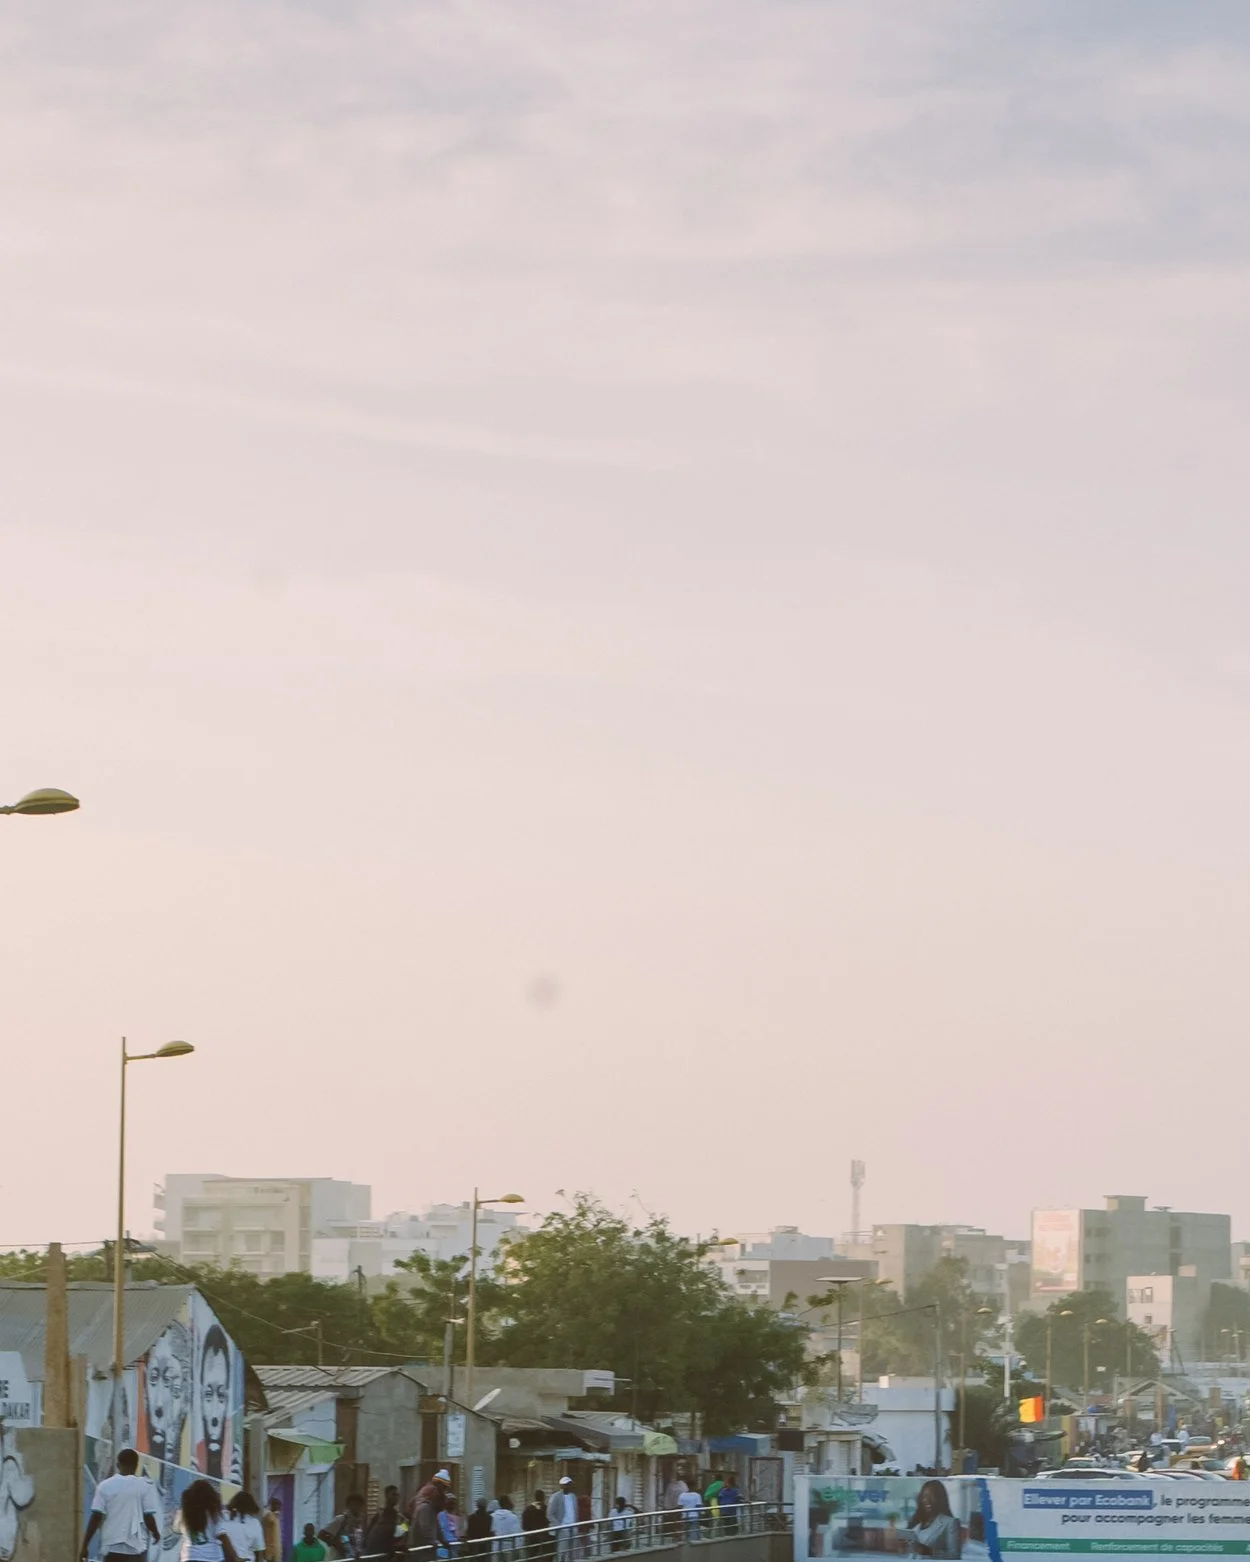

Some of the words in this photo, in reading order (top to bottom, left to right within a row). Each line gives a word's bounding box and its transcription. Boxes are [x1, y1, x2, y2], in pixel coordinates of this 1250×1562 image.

[1024, 1493, 1066, 1506] Ellever
[1069, 1496, 1092, 1508] par
[1161, 1495, 1172, 1506] le
[1176, 1497, 1250, 1509] programme
[1062, 1514, 1092, 1525] pour
[1095, 1514, 1184, 1526] accompagner
[1187, 1513, 1205, 1524] les
[1006, 1540, 1071, 1550] Financement
[1090, 1541, 1159, 1552] Renforcement
[1160, 1542, 1173, 1552] de
[1175, 1543, 1224, 1553] capacités
